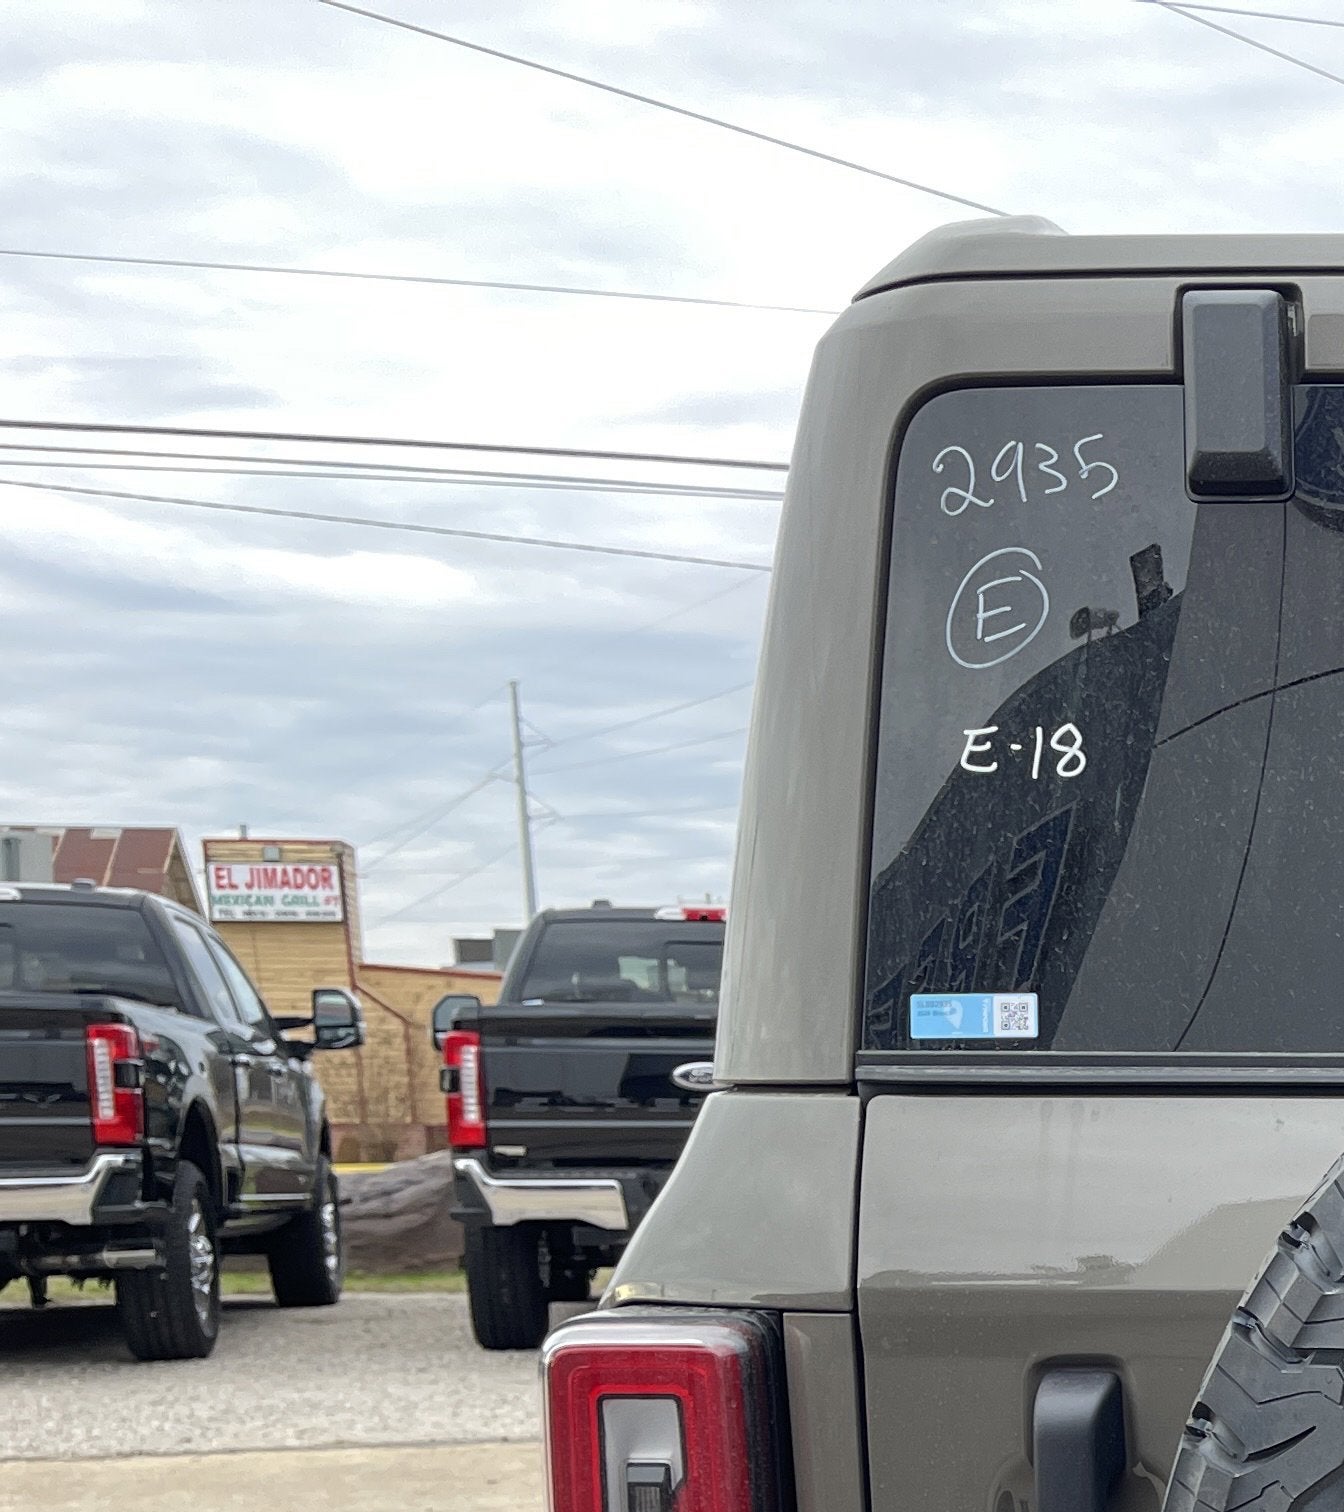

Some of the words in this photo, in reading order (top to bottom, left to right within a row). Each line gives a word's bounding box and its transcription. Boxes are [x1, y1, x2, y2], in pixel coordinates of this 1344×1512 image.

[932, 433, 1119, 517] 2935
[975, 574, 1032, 643] E
[959, 723, 1088, 779] E-18
[214, 866, 239, 890] EL
[245, 866, 334, 891] JIMADOR
